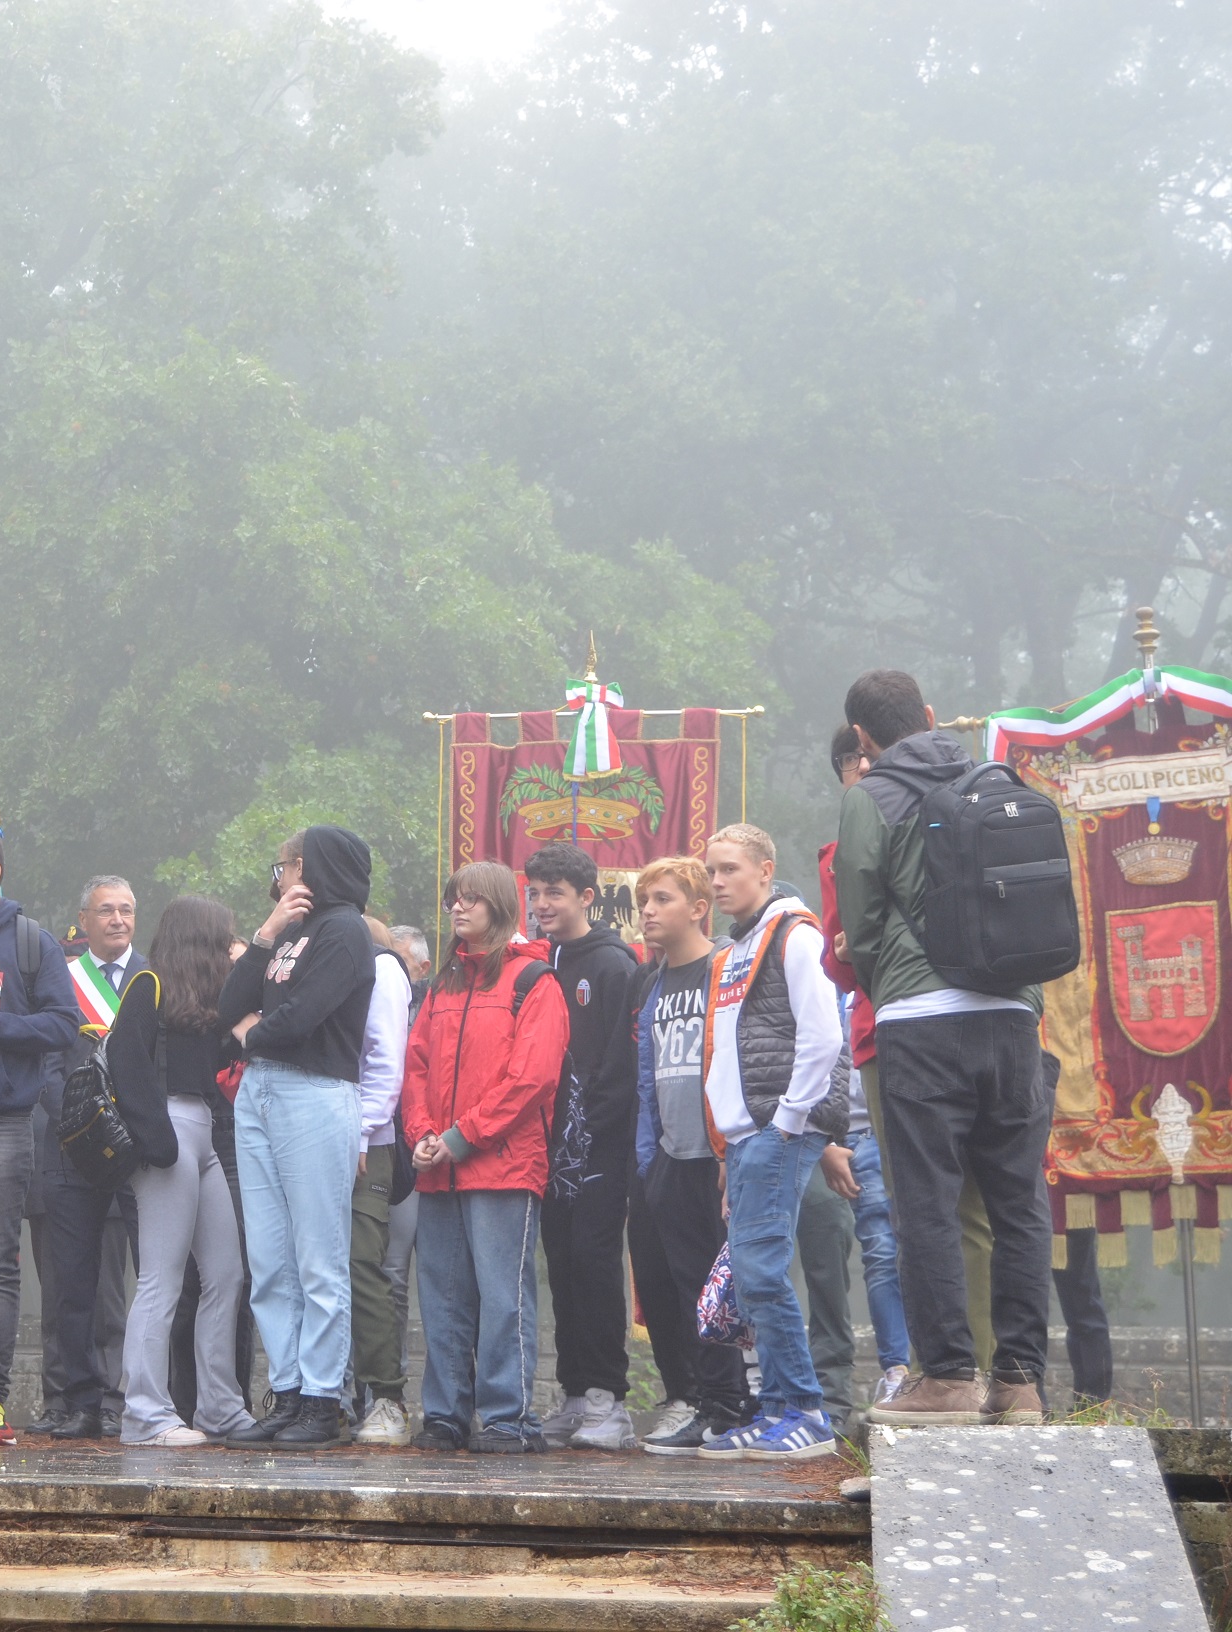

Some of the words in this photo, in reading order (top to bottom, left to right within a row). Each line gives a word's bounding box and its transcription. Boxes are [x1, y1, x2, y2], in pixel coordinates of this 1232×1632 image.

[1082, 771, 1149, 796] ASCOLI
[1152, 765, 1226, 790] PICENO
[651, 1016, 705, 1067] Y62
